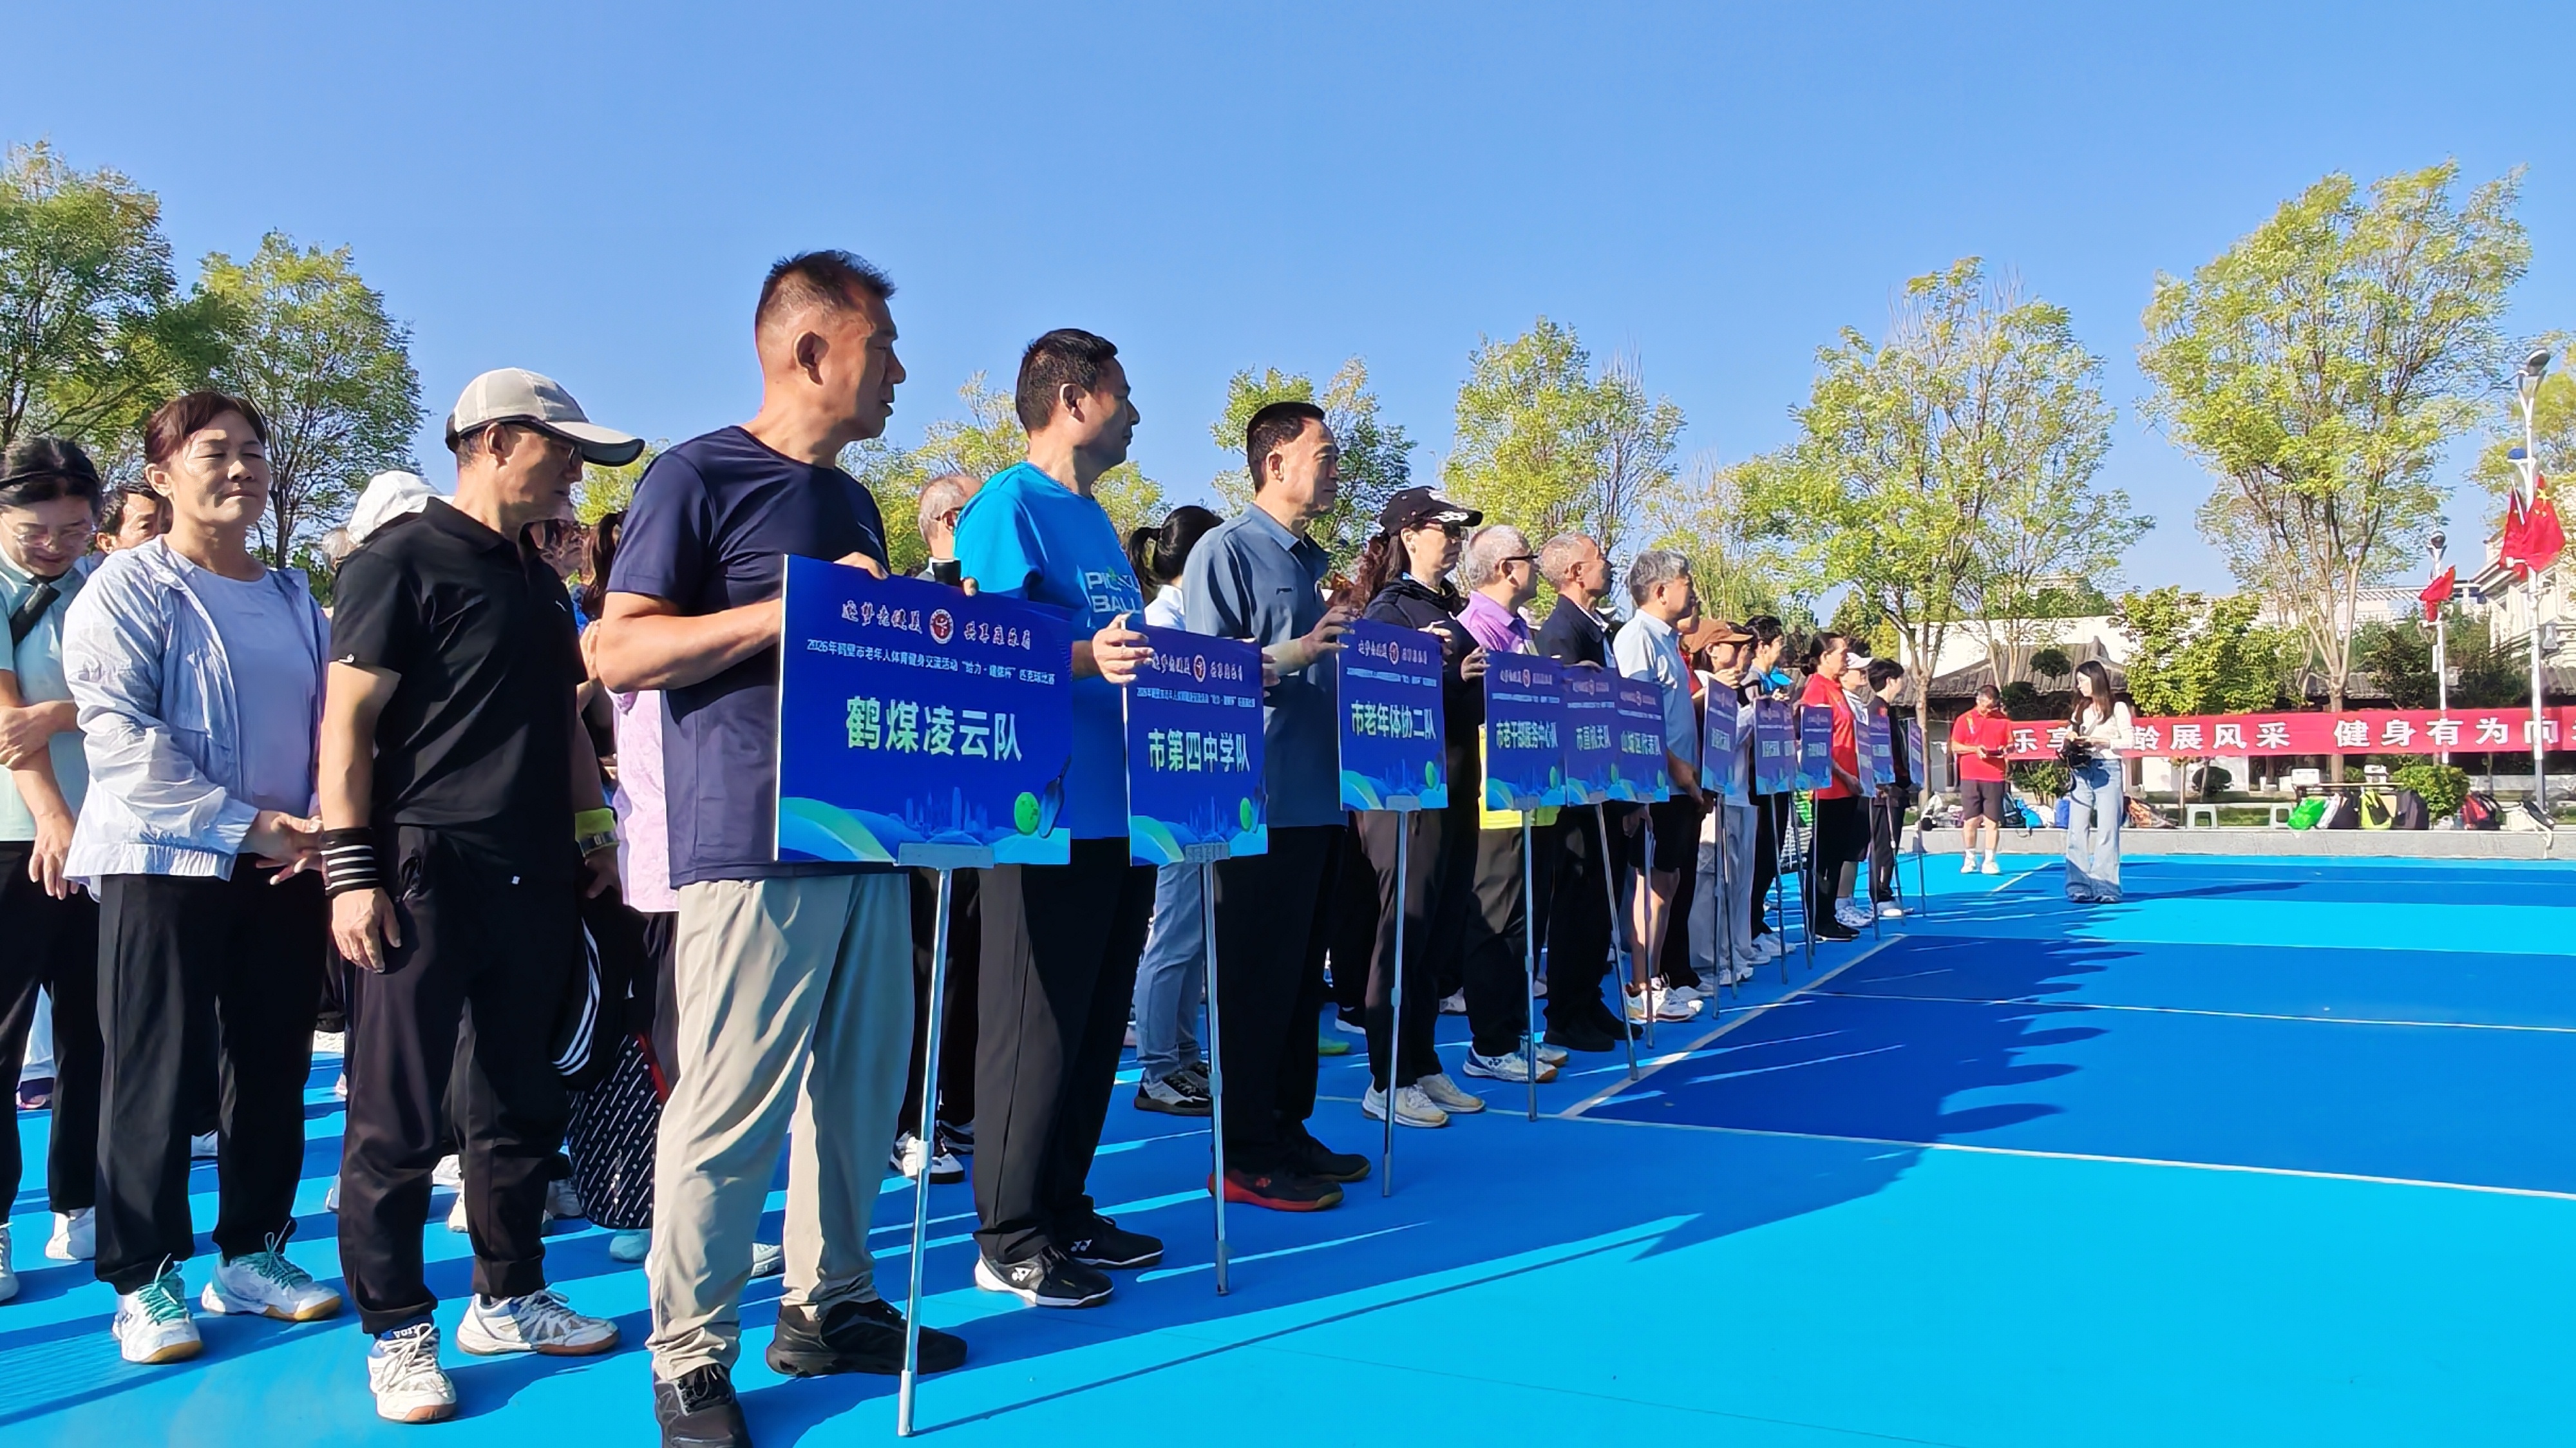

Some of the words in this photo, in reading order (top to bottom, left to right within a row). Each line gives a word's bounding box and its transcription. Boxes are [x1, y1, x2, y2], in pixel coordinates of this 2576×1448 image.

[846, 695, 1023, 762] 鹤煤凌云队
[1350, 700, 1437, 741] 市老年体协二队
[2012, 721, 2291, 754] 乐享龄展风采
[2333, 716, 2576, 748] 健身有为向
[1147, 727, 1251, 774] 市第四中学队
